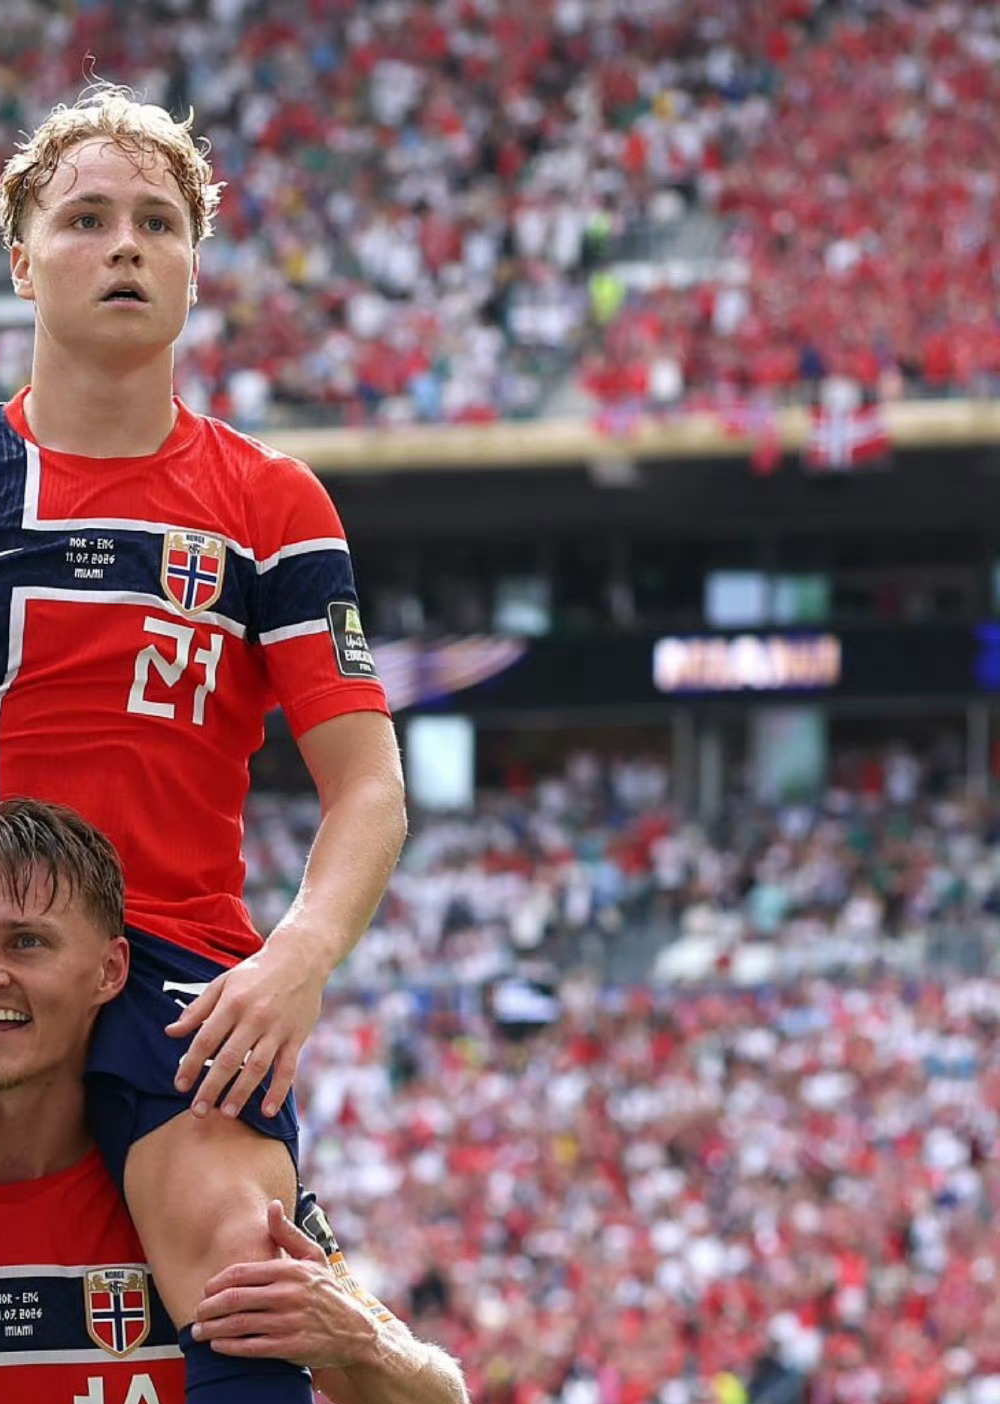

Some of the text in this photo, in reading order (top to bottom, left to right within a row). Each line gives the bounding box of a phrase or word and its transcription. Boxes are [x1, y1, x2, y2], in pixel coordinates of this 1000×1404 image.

[69, 537, 87, 548] NOR
[96, 538, 115, 550] ENG
[65, 551, 116, 565] 11.07.2026
[74, 567, 104, 579] MIAMI
[126, 615, 224, 726] 21
[22, 1291, 39, 1304] ENG
[4, 1324, 34, 1337] MIAMI
